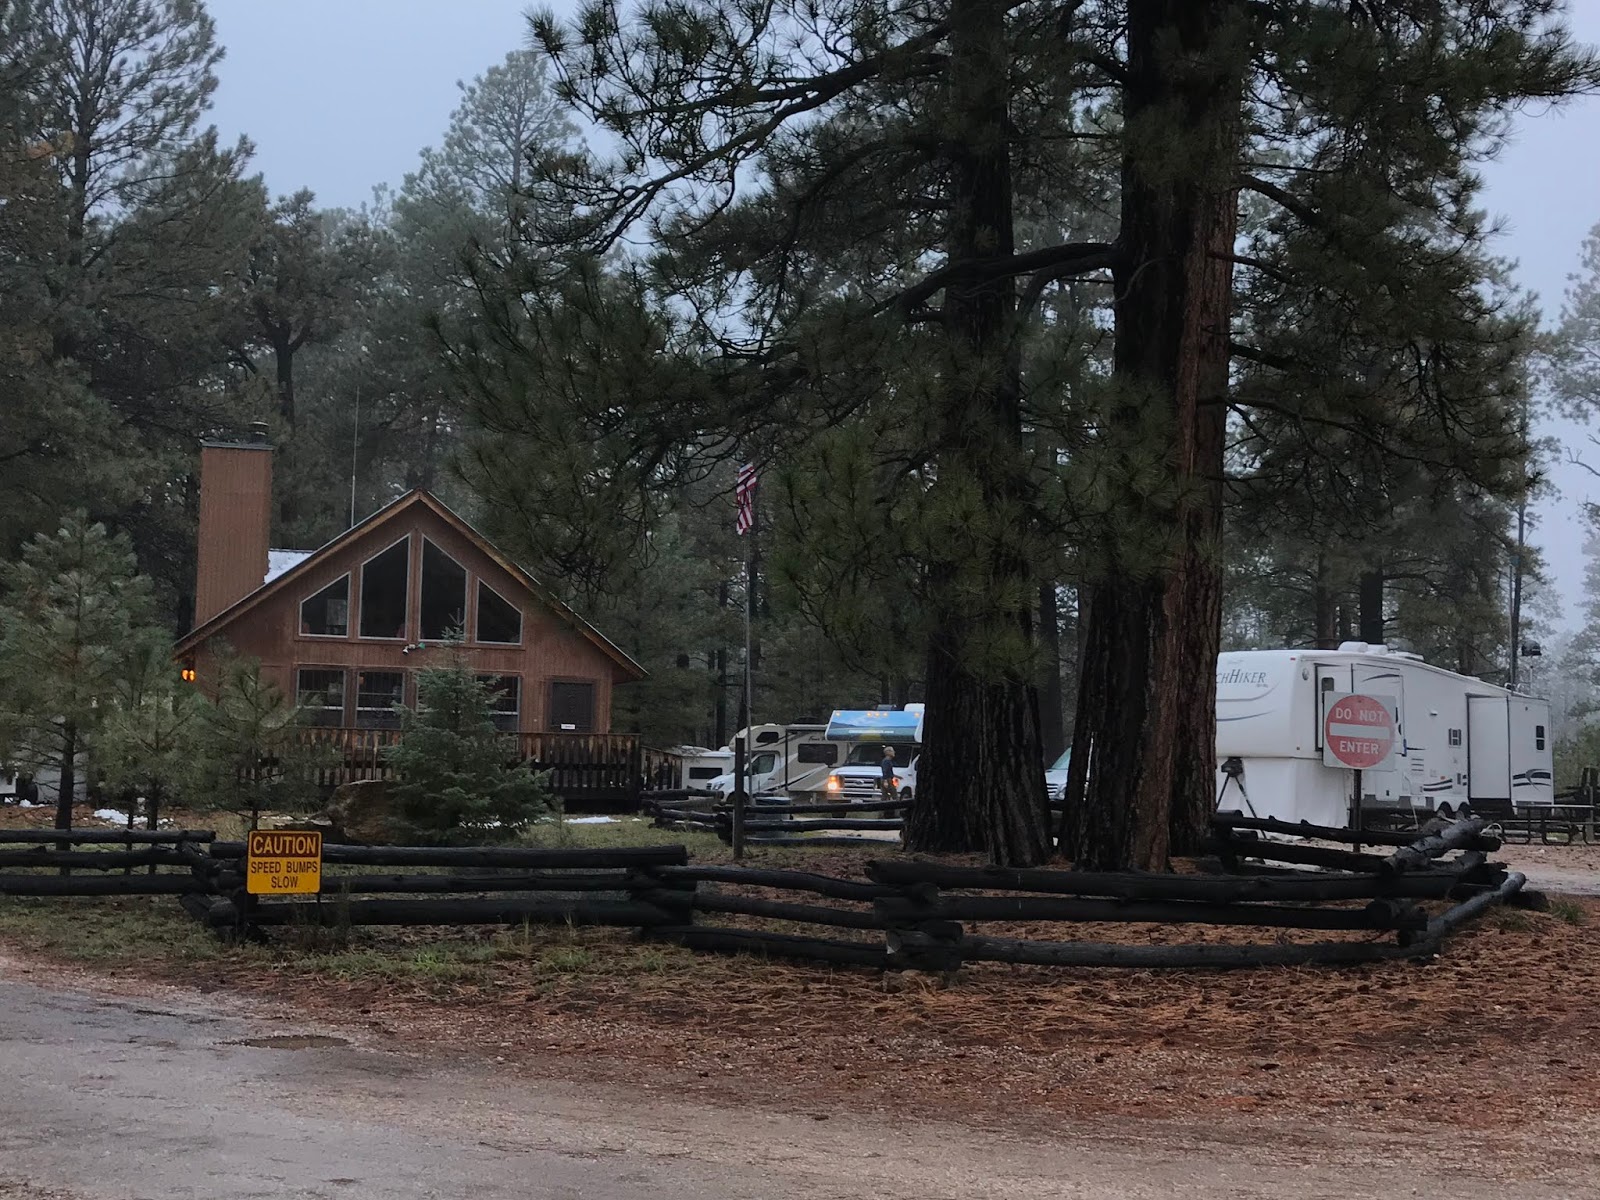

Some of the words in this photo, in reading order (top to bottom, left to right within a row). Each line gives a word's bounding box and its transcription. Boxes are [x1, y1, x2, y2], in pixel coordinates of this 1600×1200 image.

[1335, 707, 1352, 720] DO
[1359, 709, 1385, 722] NOT
[1339, 740, 1379, 755] ENTER
[253, 835, 317, 854] CAUTION
[251, 861, 281, 874] SPEED
[286, 860, 318, 874] BUMPS
[271, 876, 299, 889] SLOW
